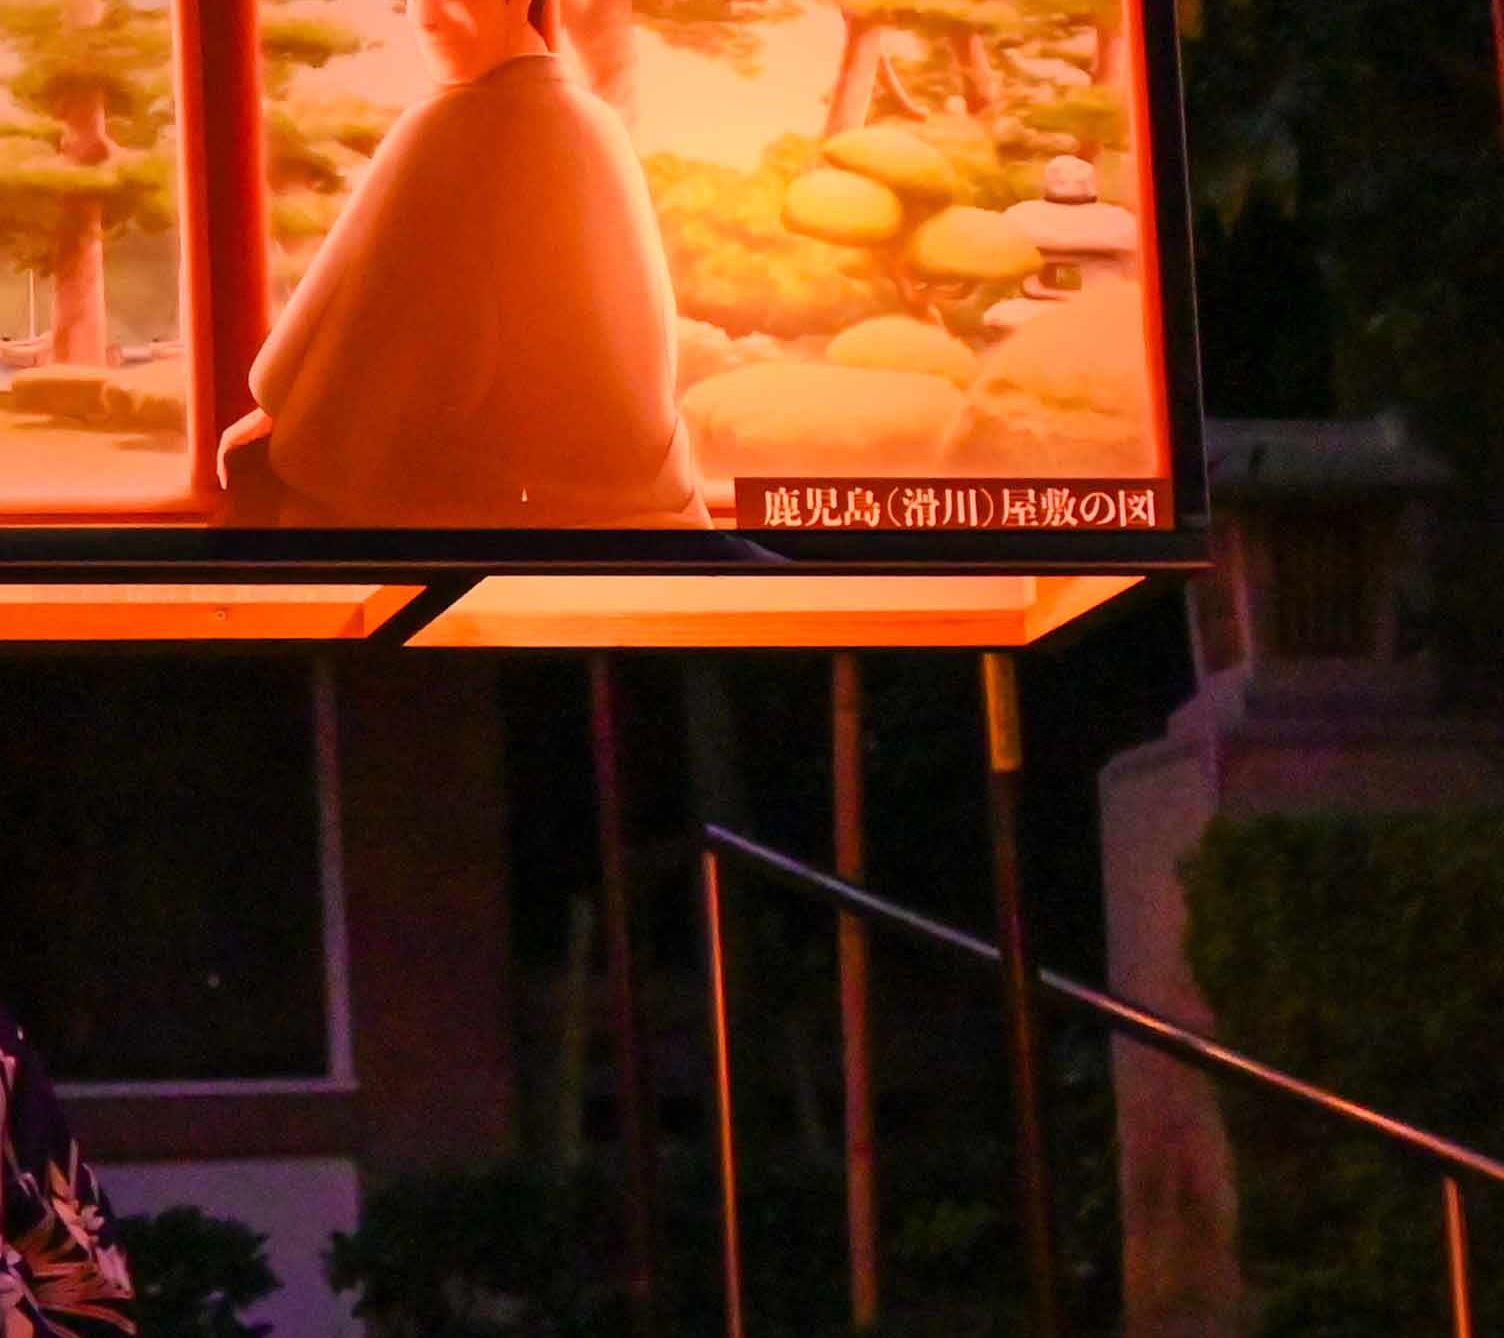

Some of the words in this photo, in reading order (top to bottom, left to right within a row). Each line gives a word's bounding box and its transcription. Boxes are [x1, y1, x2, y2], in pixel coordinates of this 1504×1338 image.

[763, 486, 1157, 529] 鹿児島(滑川)屋敷の図
